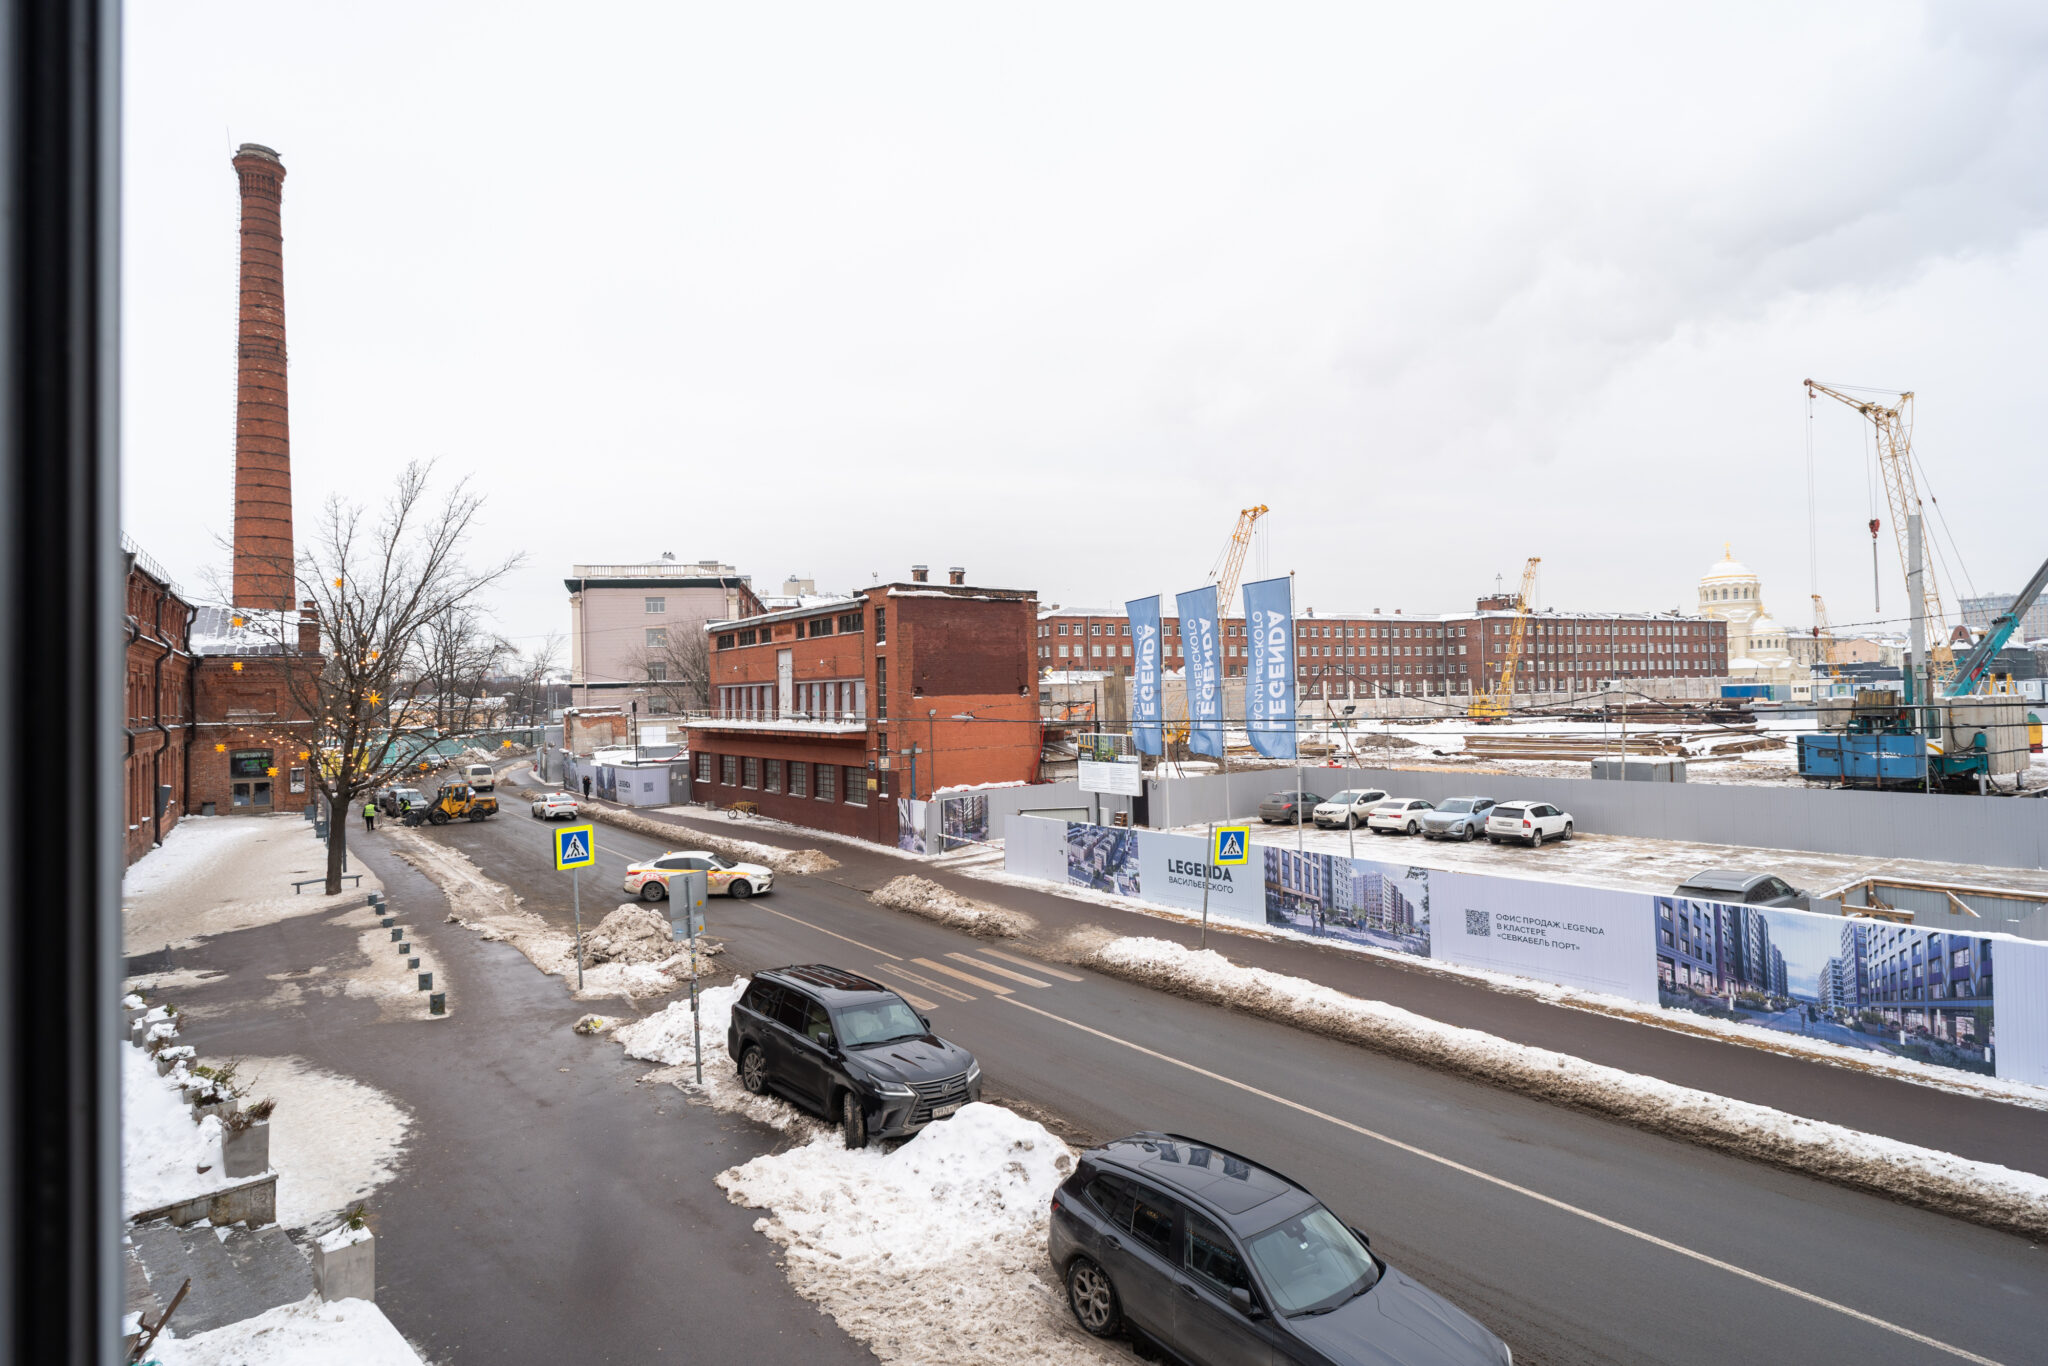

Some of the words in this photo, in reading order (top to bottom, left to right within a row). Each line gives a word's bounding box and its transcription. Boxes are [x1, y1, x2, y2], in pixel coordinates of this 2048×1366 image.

[1168, 858, 1233, 882] LEGENDA
[1495, 913, 1522, 924] ОФИС
[1522, 916, 1561, 929] ПРОДАЖ
[1562, 922, 1605, 936] LEGENDA
[1496, 922, 1503, 930] В
[1503, 923, 1547, 937] КЛАСТЕРЕ
[1497, 932, 1550, 947] «СЕВКАБЕЛЬ
[1551, 940, 1581, 951] ПОРТ»
